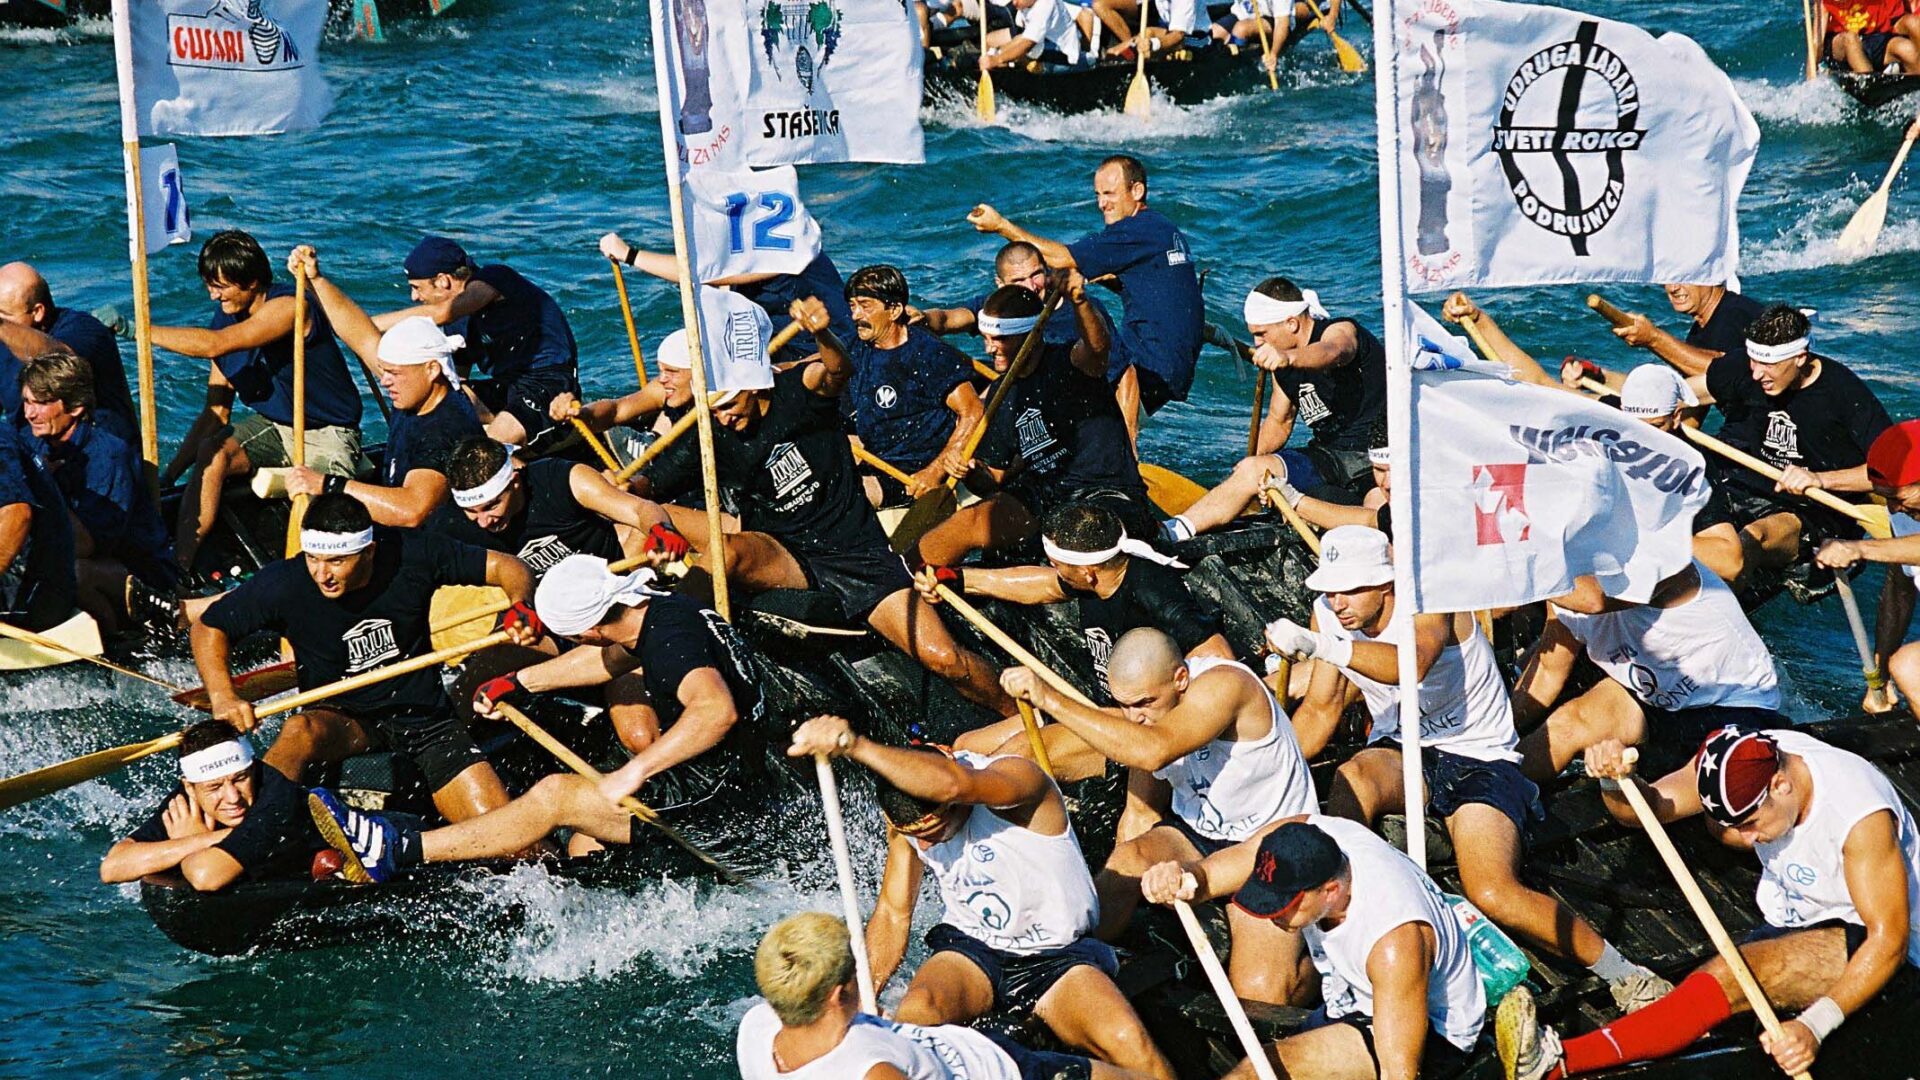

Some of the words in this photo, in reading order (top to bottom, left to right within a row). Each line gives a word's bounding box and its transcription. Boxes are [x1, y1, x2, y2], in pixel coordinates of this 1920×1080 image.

[174, 26, 245, 63] GUSARI
[1504, 43, 1581, 112] UDRUGA
[763, 104, 840, 140] STAŠEVICA
[1495, 130, 1557, 150] SVETI
[1561, 131, 1639, 150] ROKO
[693, 148, 711, 164] ZA
[725, 190, 796, 254] 12
[732, 310, 754, 361] ATRIUM
[769, 445, 808, 488] ATRIUM
[347, 624, 397, 660] ATRIUM
